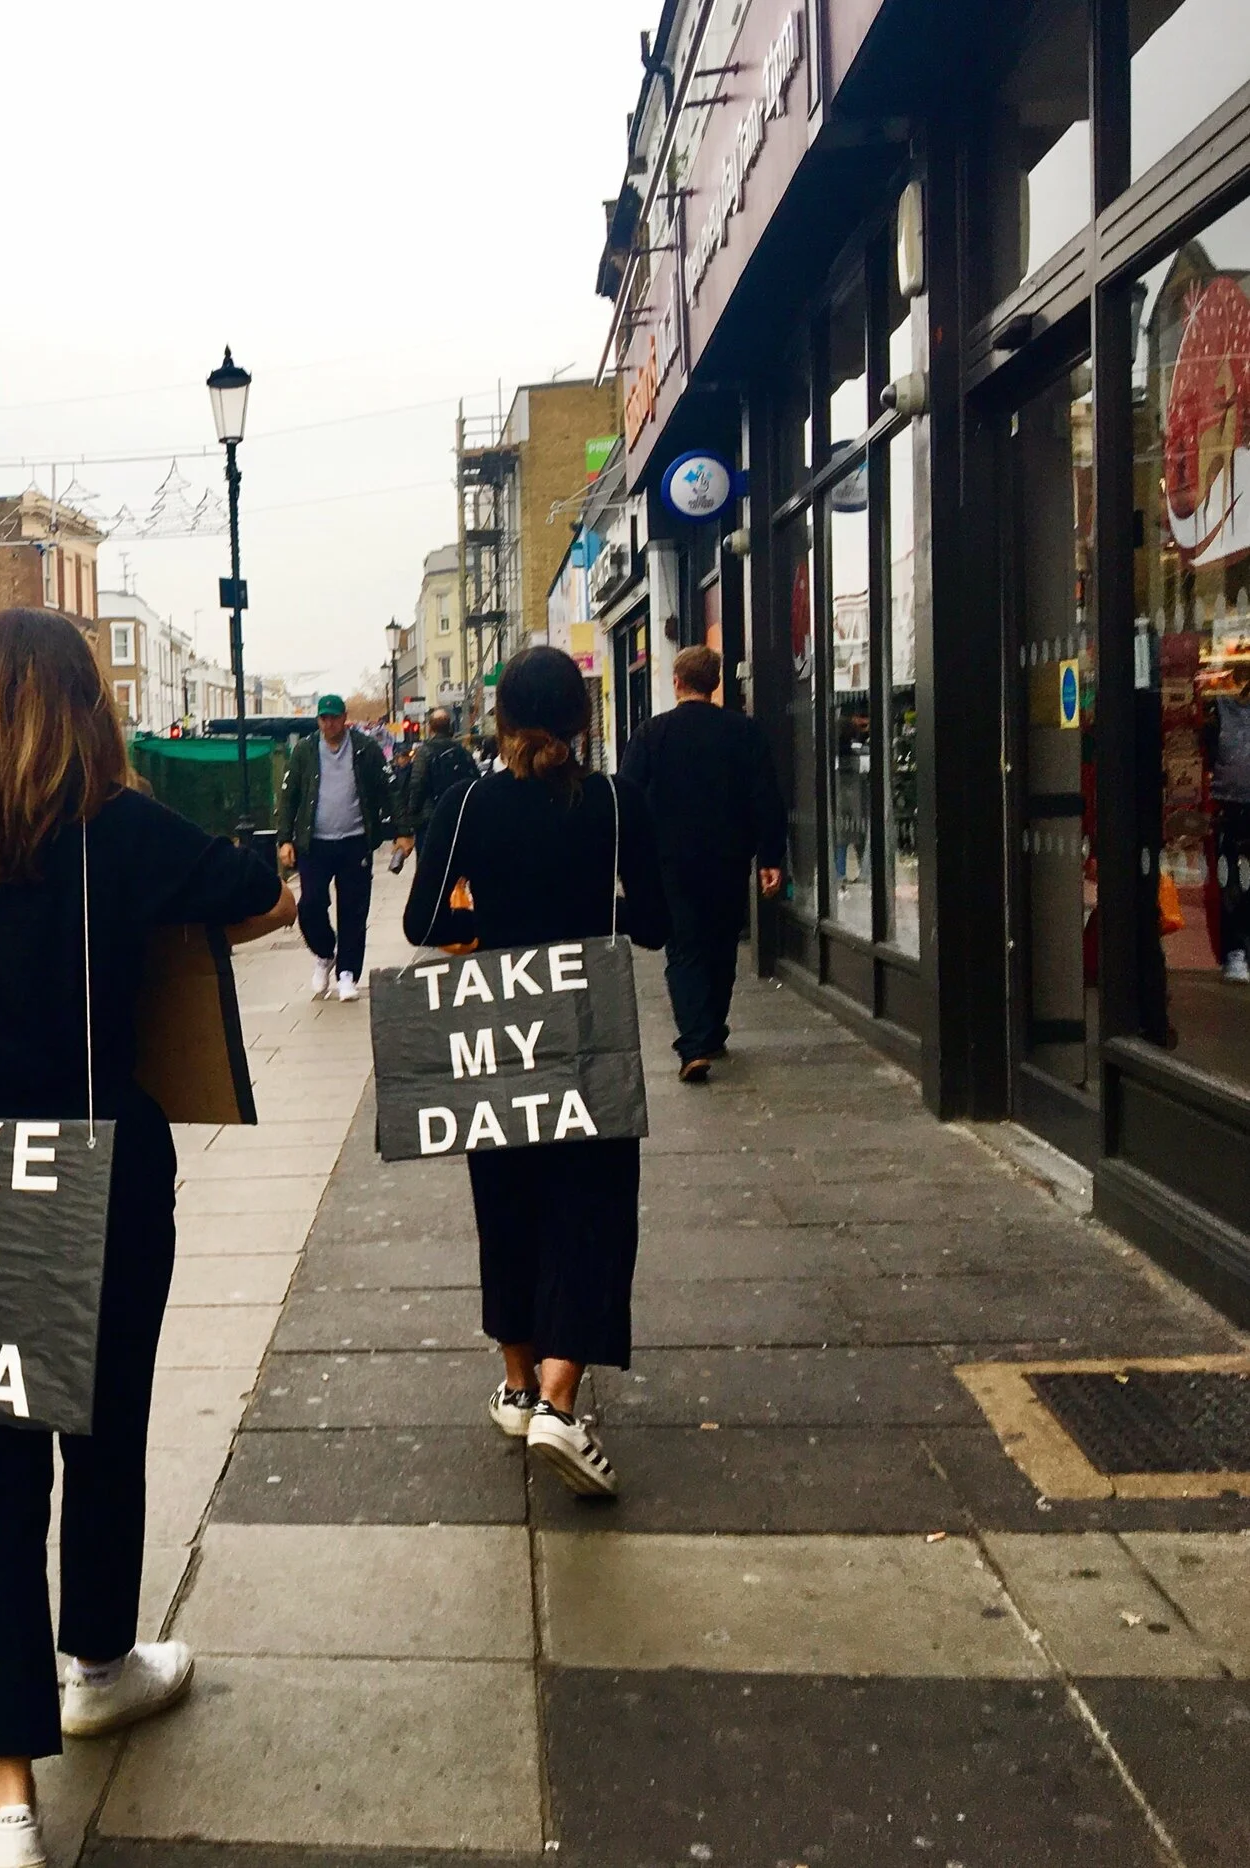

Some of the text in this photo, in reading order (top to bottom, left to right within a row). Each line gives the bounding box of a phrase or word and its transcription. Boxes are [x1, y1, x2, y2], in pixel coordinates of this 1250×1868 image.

[414, 943, 588, 1011] TAKE
[449, 1020, 545, 1080] MY
[418, 1089, 599, 1155] DATA
